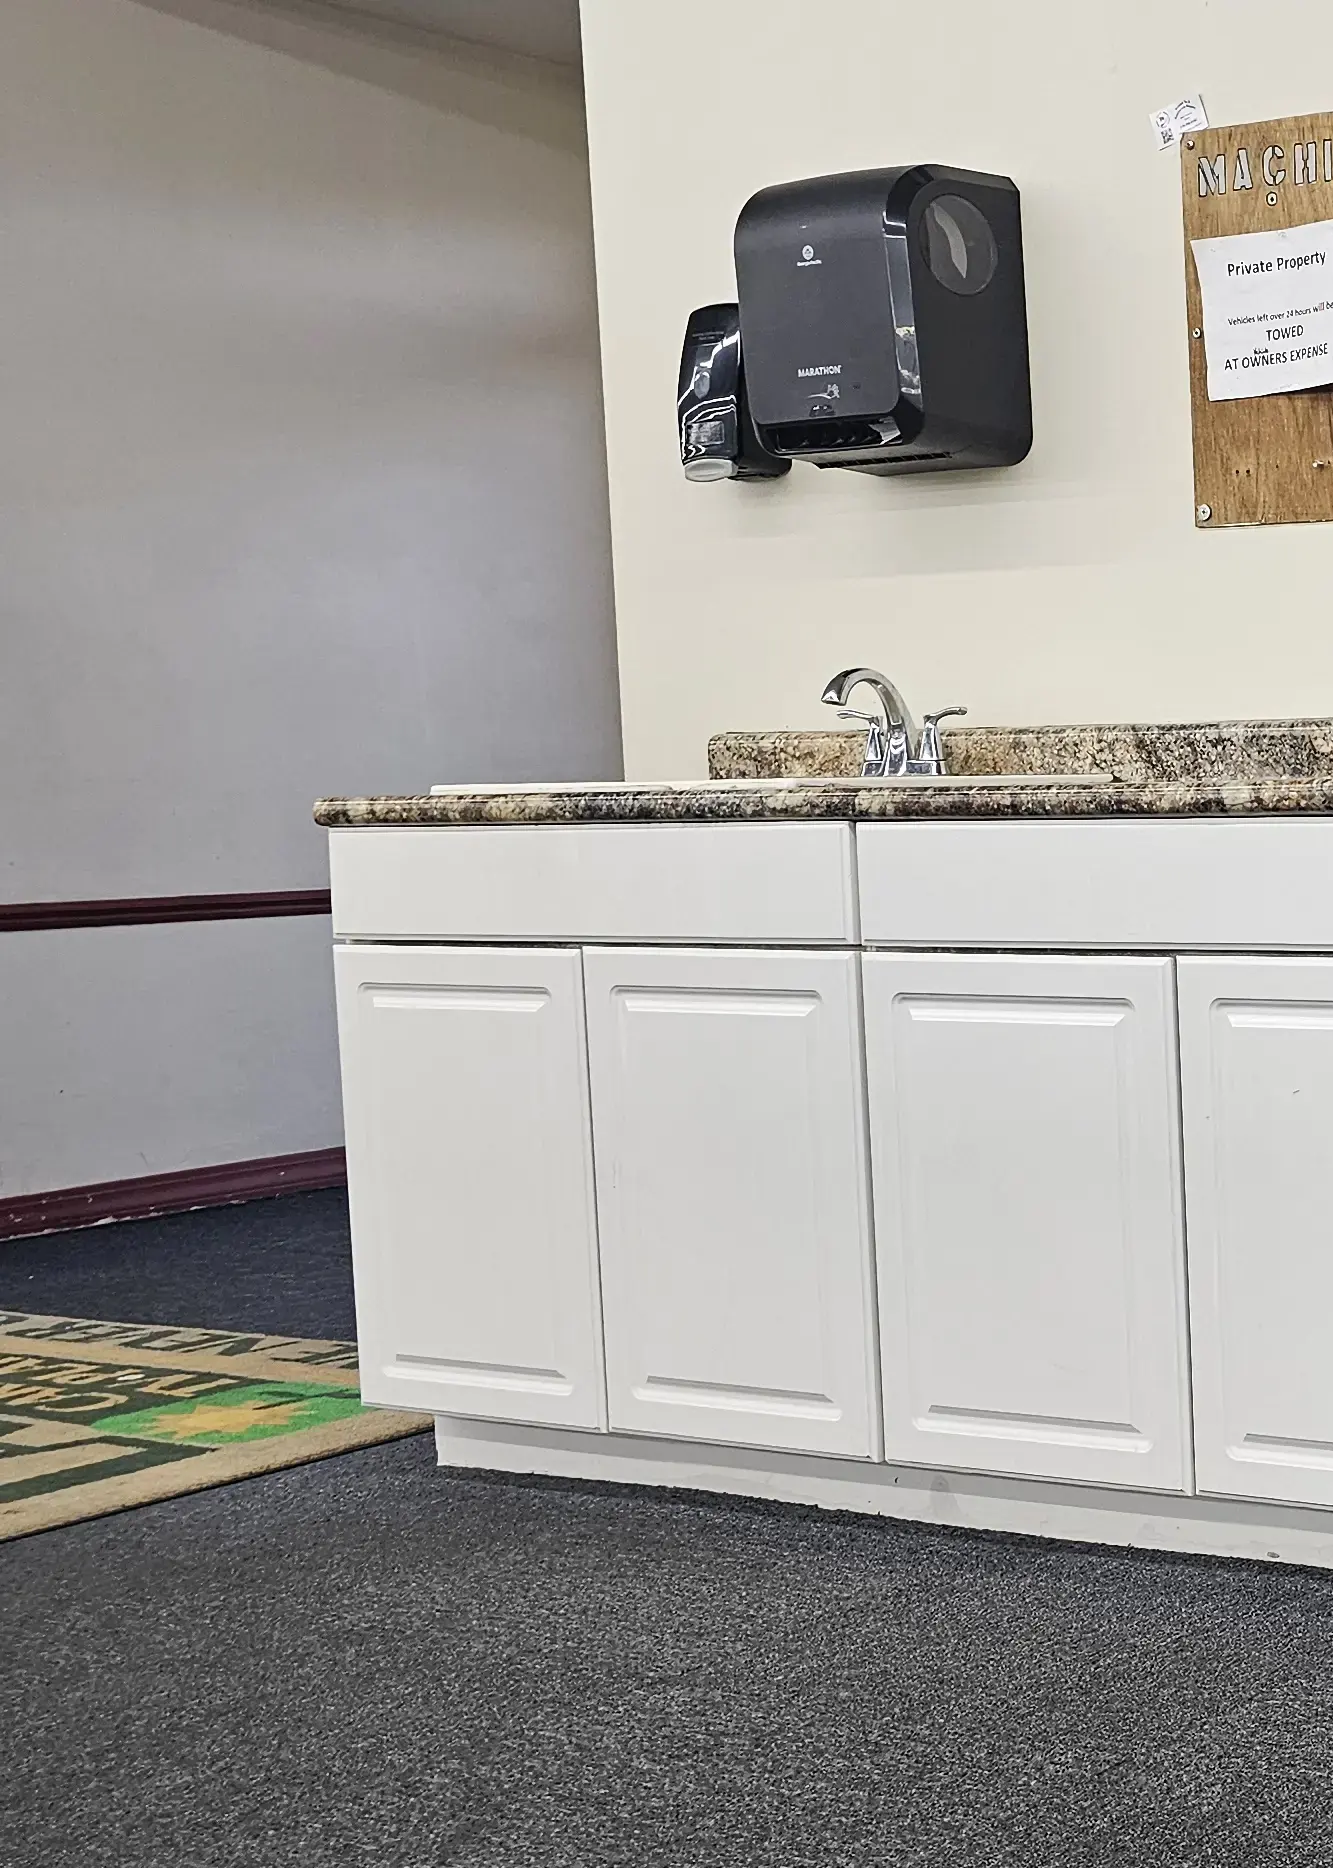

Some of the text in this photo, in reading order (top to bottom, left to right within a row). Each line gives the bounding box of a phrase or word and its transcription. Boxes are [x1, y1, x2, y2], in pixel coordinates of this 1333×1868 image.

[1227, 251, 1326, 277] Private Property
[1228, 314, 1255, 326] Vehicles
[1257, 312, 1269, 322] left
[1270, 313, 1285, 321] over
[1294, 308, 1311, 318] hours
[1312, 302, 1325, 312] will
[1266, 324, 1304, 341] TOWED
[1224, 342, 1328, 371] AT OWNERS EXPENSE
[797, 365, 840, 377] MARATHON
